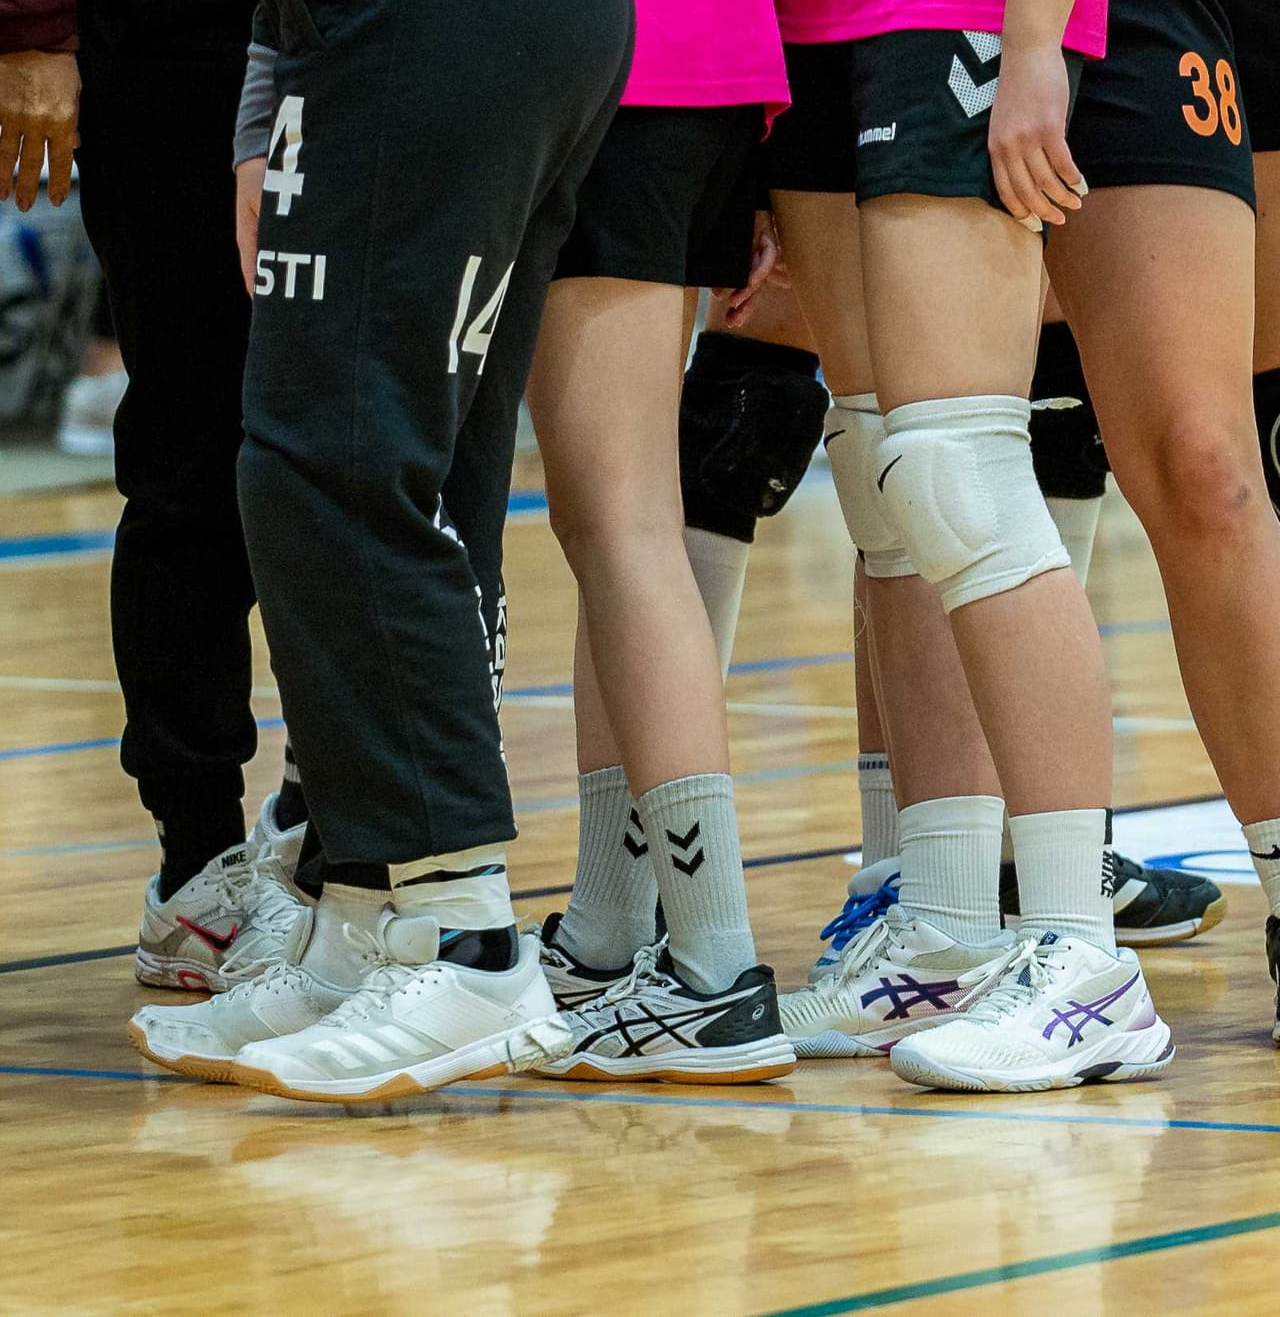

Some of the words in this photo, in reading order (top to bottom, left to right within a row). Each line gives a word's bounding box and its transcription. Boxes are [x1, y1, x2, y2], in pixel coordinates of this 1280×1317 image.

[1178, 51, 1242, 146] 38
[221, 849, 246, 869] NIKE
[1100, 850, 1113, 900] NIKE
